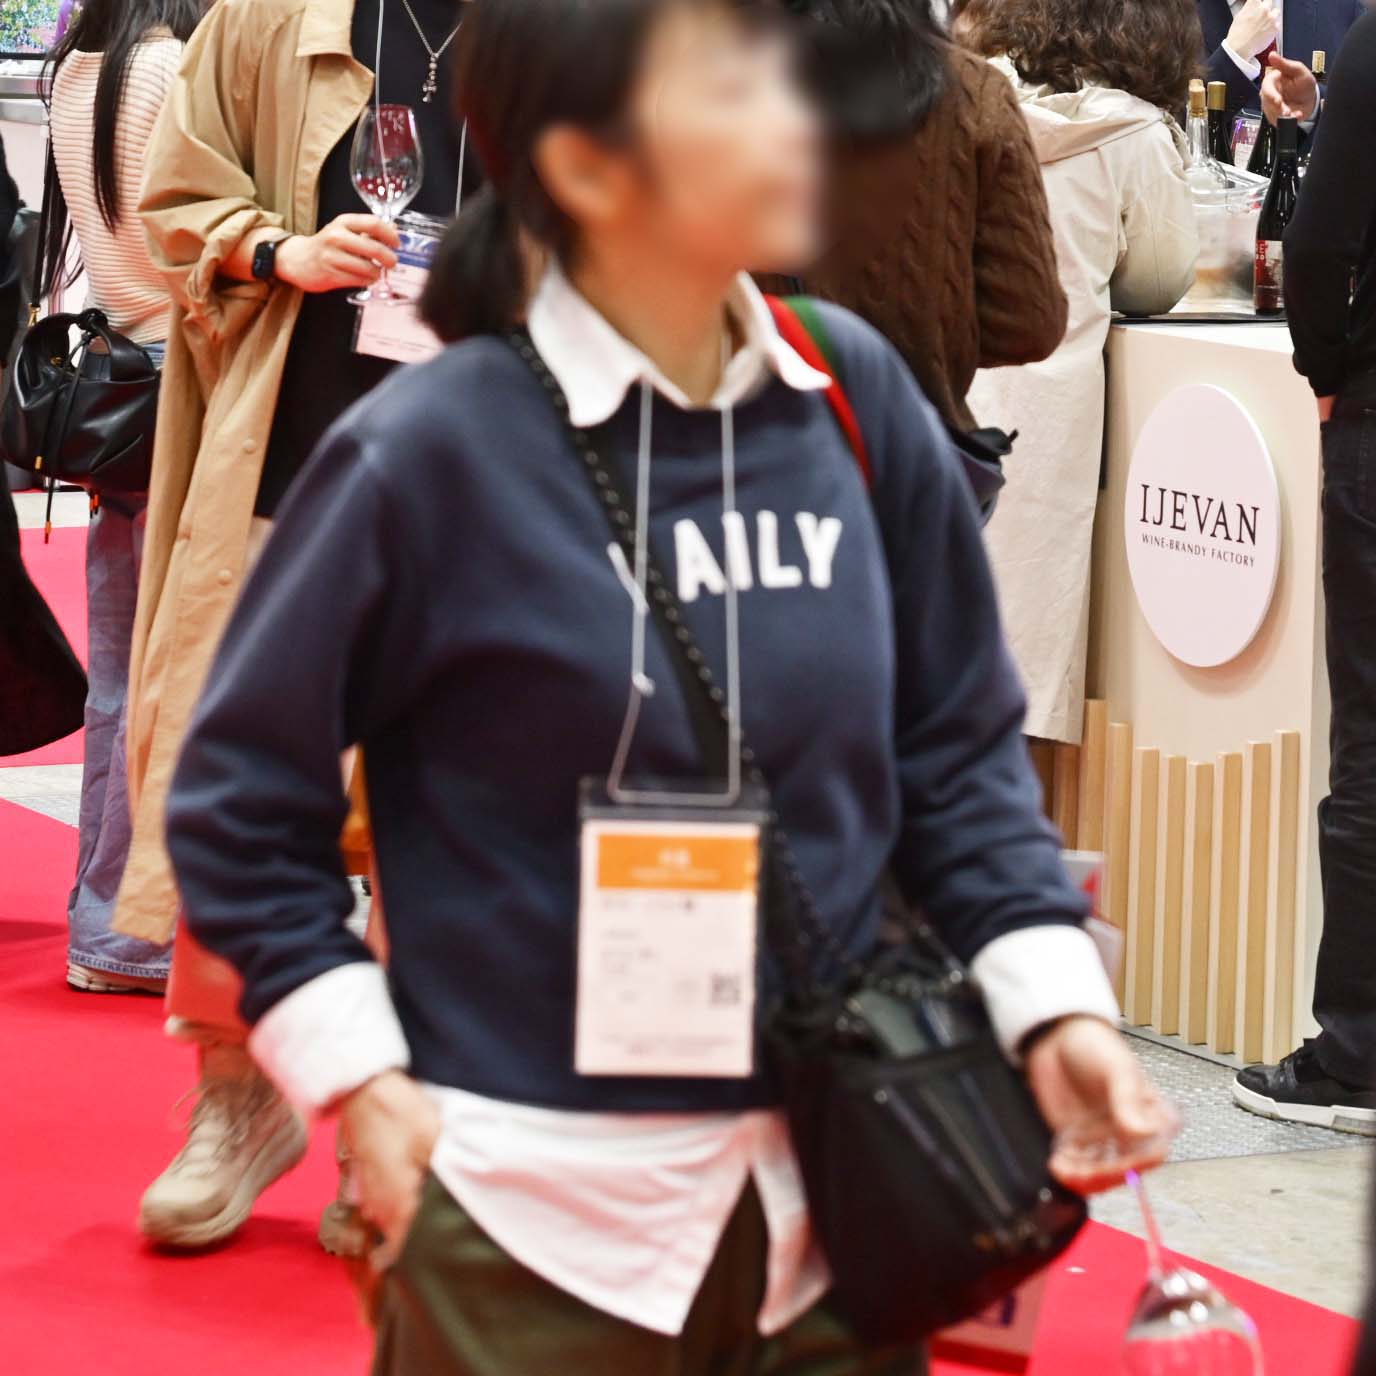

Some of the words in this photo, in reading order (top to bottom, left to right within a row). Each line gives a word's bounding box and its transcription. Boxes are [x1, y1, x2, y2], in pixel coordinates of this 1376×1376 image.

[1140, 484, 1260, 546] IJEVAN
[606, 508, 843, 612] AILY
[1141, 532, 1208, 557] WINE-BRANDY
[1211, 548, 1256, 568] FACTORY
